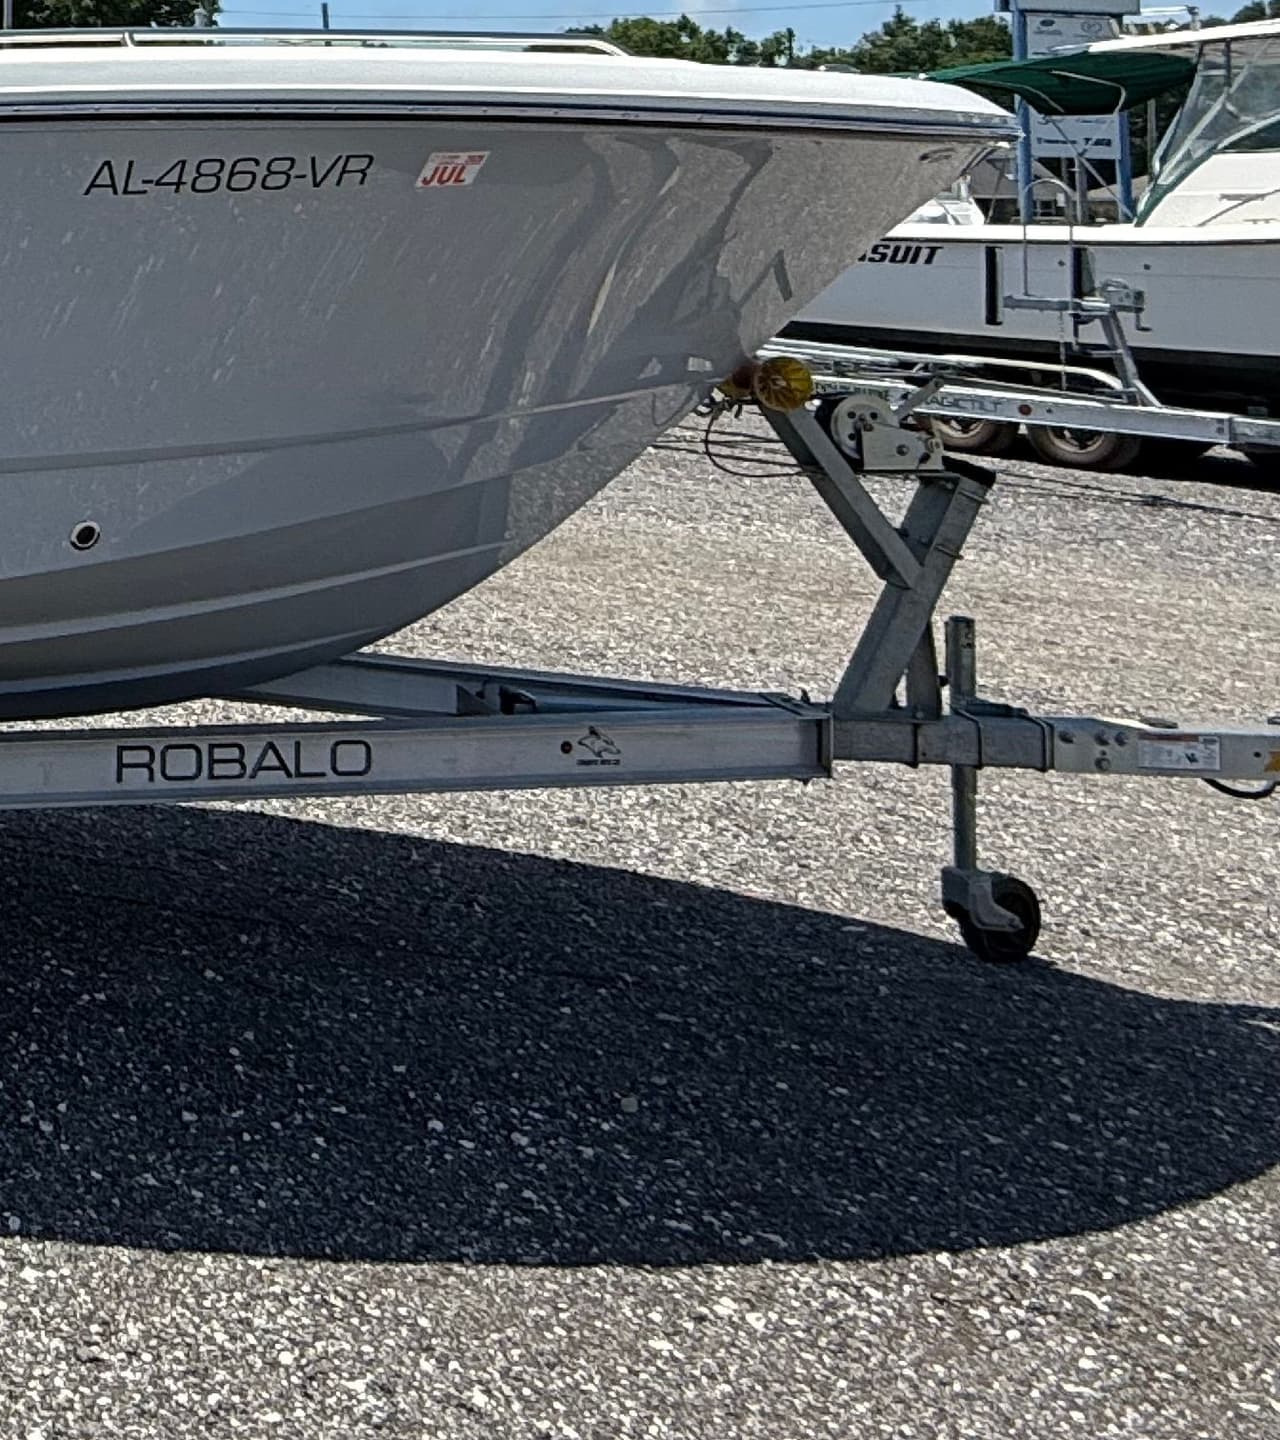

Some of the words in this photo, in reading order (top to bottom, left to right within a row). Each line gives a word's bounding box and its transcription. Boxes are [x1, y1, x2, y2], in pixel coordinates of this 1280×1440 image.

[83, 154, 375, 196] AL-4868-VR
[422, 165, 466, 186] JUL
[858, 244, 944, 265] SUIT
[116, 740, 372, 783] ROBALO
